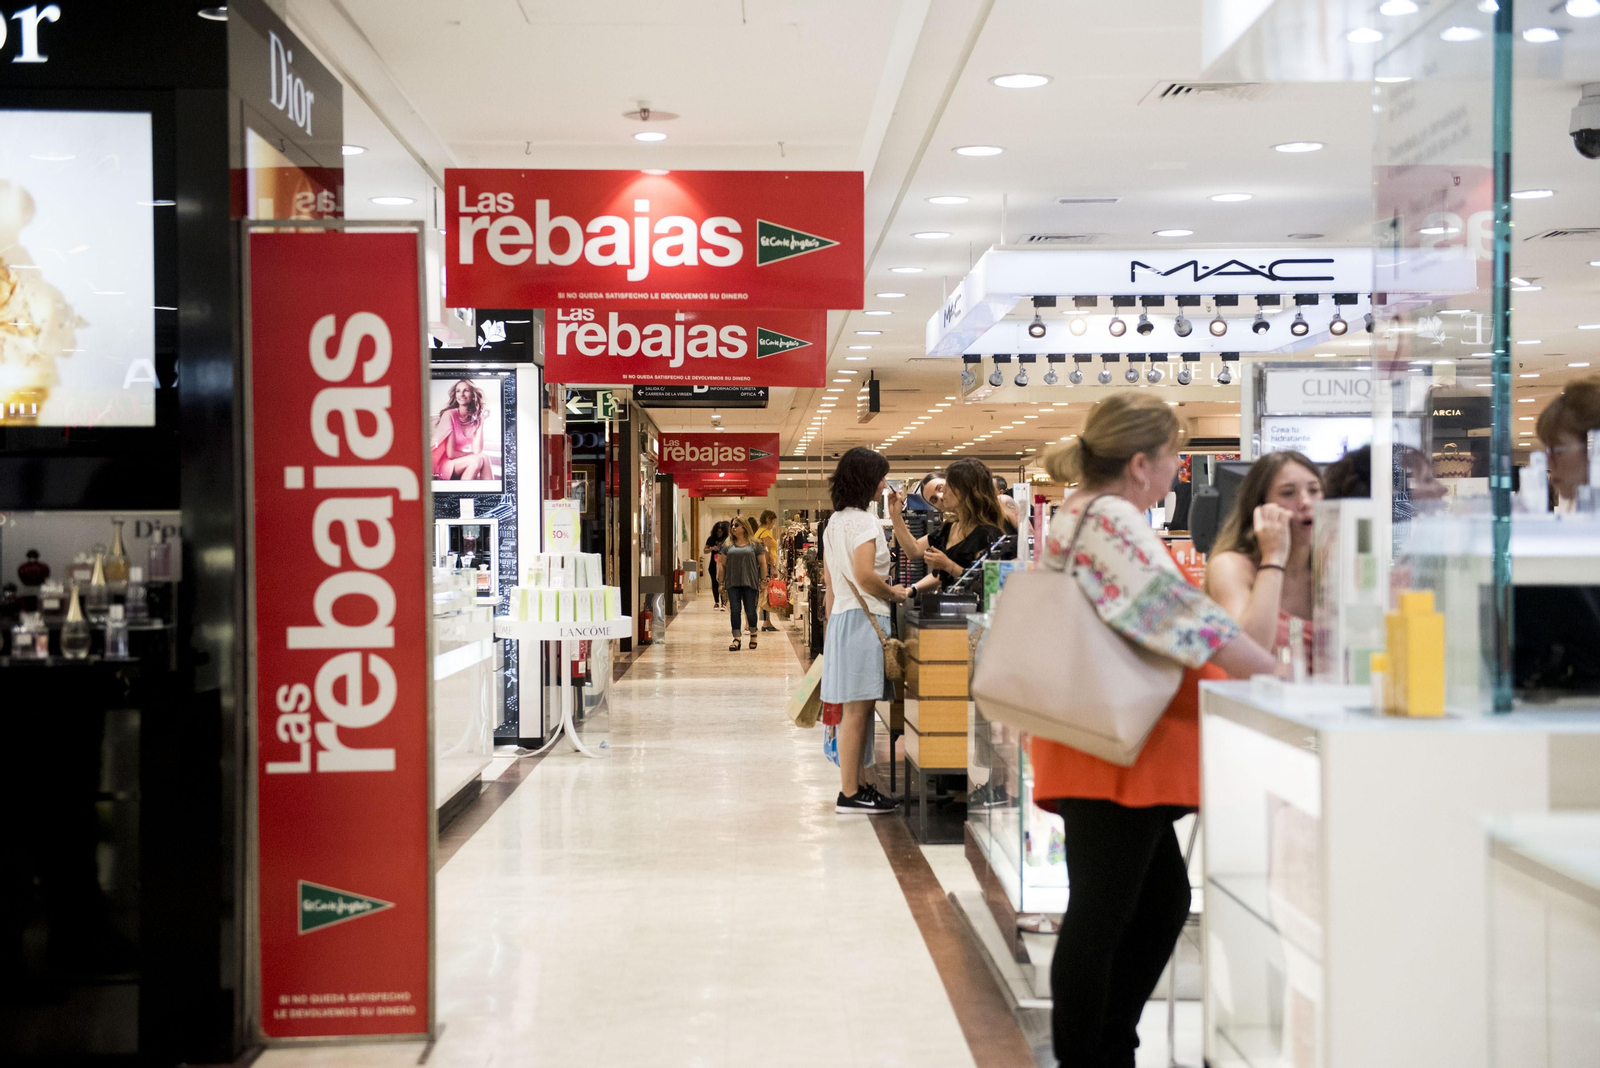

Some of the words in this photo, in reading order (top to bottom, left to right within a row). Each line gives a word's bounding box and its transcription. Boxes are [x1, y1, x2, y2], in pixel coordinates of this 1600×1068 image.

[269, 30, 314, 136] Dior
[458, 185, 515, 214] Las
[458, 199, 744, 282] rebajas
[557, 308, 595, 321] Las
[556, 312, 748, 368] rebajas
[663, 438, 680, 447] Las
[663, 442, 746, 466] rebajas
[284, 312, 420, 772] rebajas
[560, 626, 612, 637] LANCÔME
[266, 683, 311, 774] Las
[279, 994, 290, 1005] SI
[292, 994, 308, 1004] NO
[309, 993, 346, 1004] QUEDA
[347, 991, 411, 1003] SATISFECHO
[273, 1008, 289, 1020] LE
[289, 1006, 359, 1019] DEVOLVEMOS
[360, 1006, 375, 1017] SU
[376, 1004, 416, 1016] DINERO
